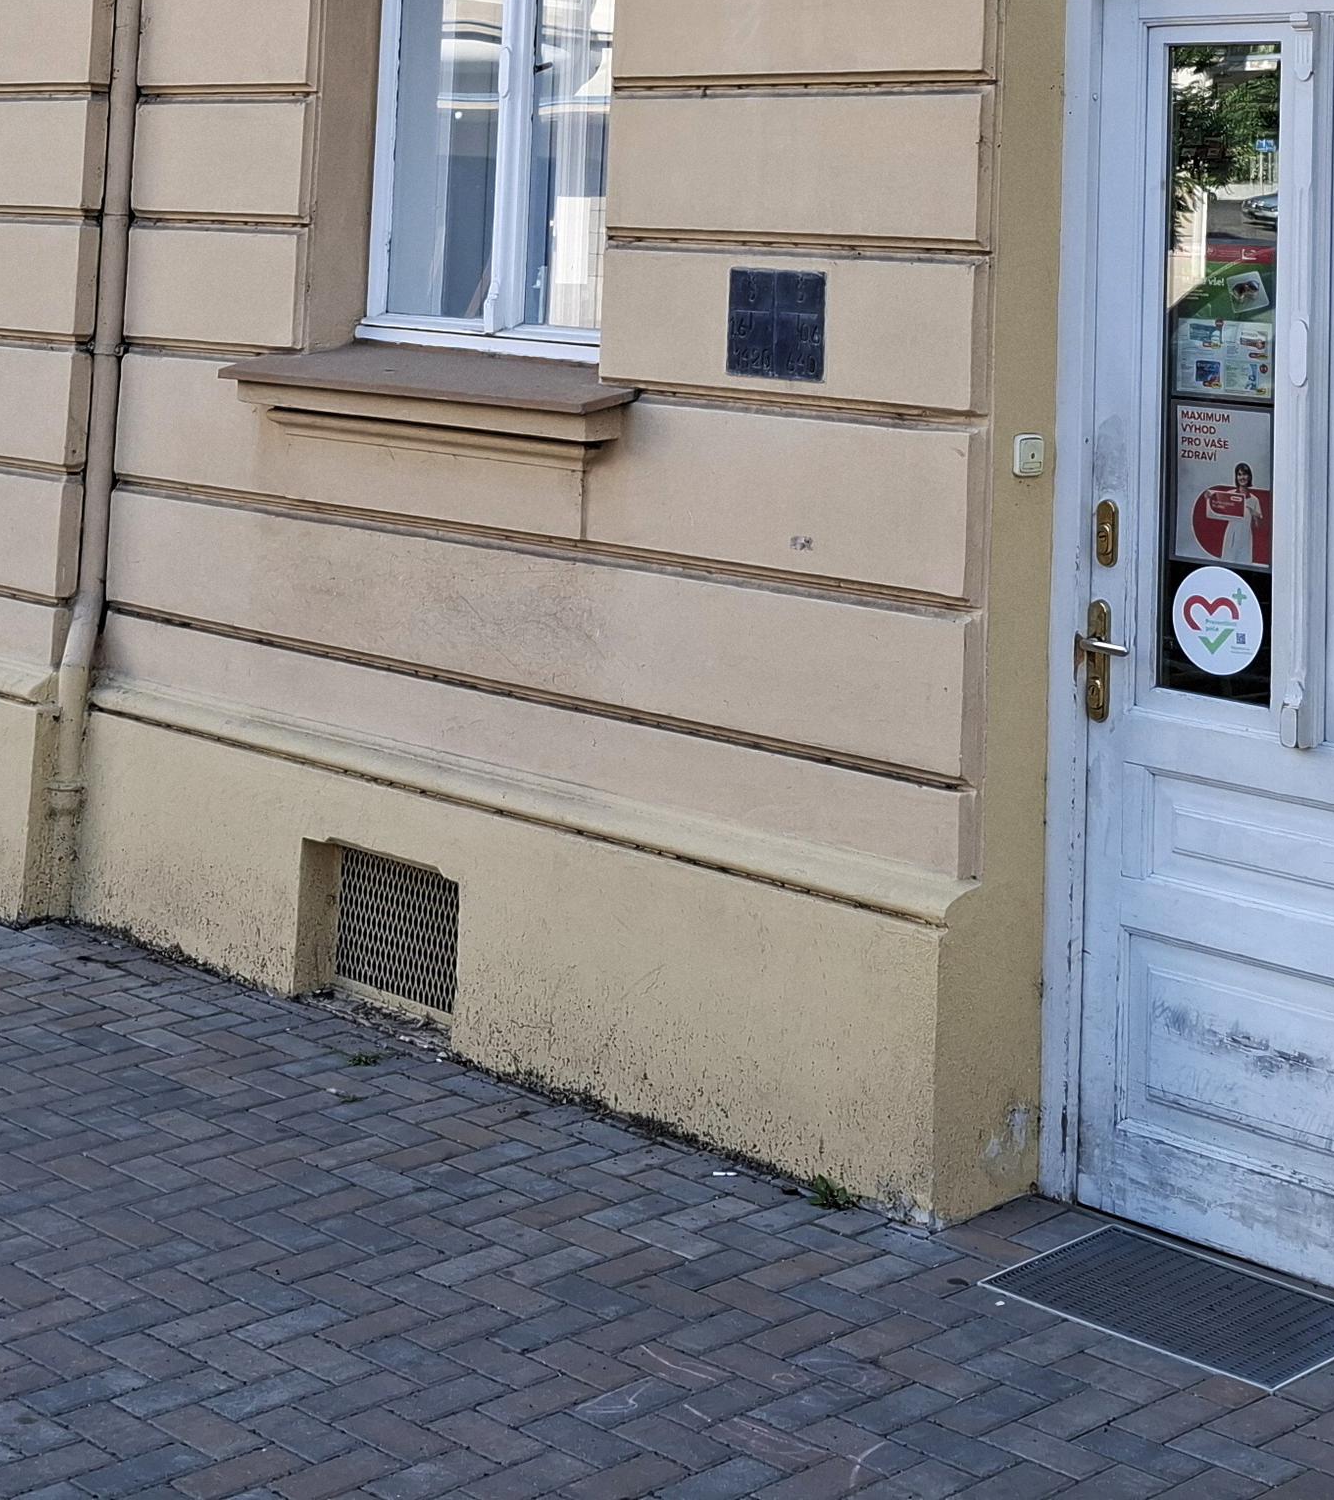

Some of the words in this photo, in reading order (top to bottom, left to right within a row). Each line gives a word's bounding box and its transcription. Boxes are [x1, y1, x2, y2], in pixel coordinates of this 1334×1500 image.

[1181, 410, 1230, 423] MAXIMUM
[1181, 421, 1216, 435] VÝHOD
[1181, 436, 1201, 447] PRO
[1204, 437, 1230, 450] VAŠE
[1181, 449, 1217, 461] ZDRAVÍ
